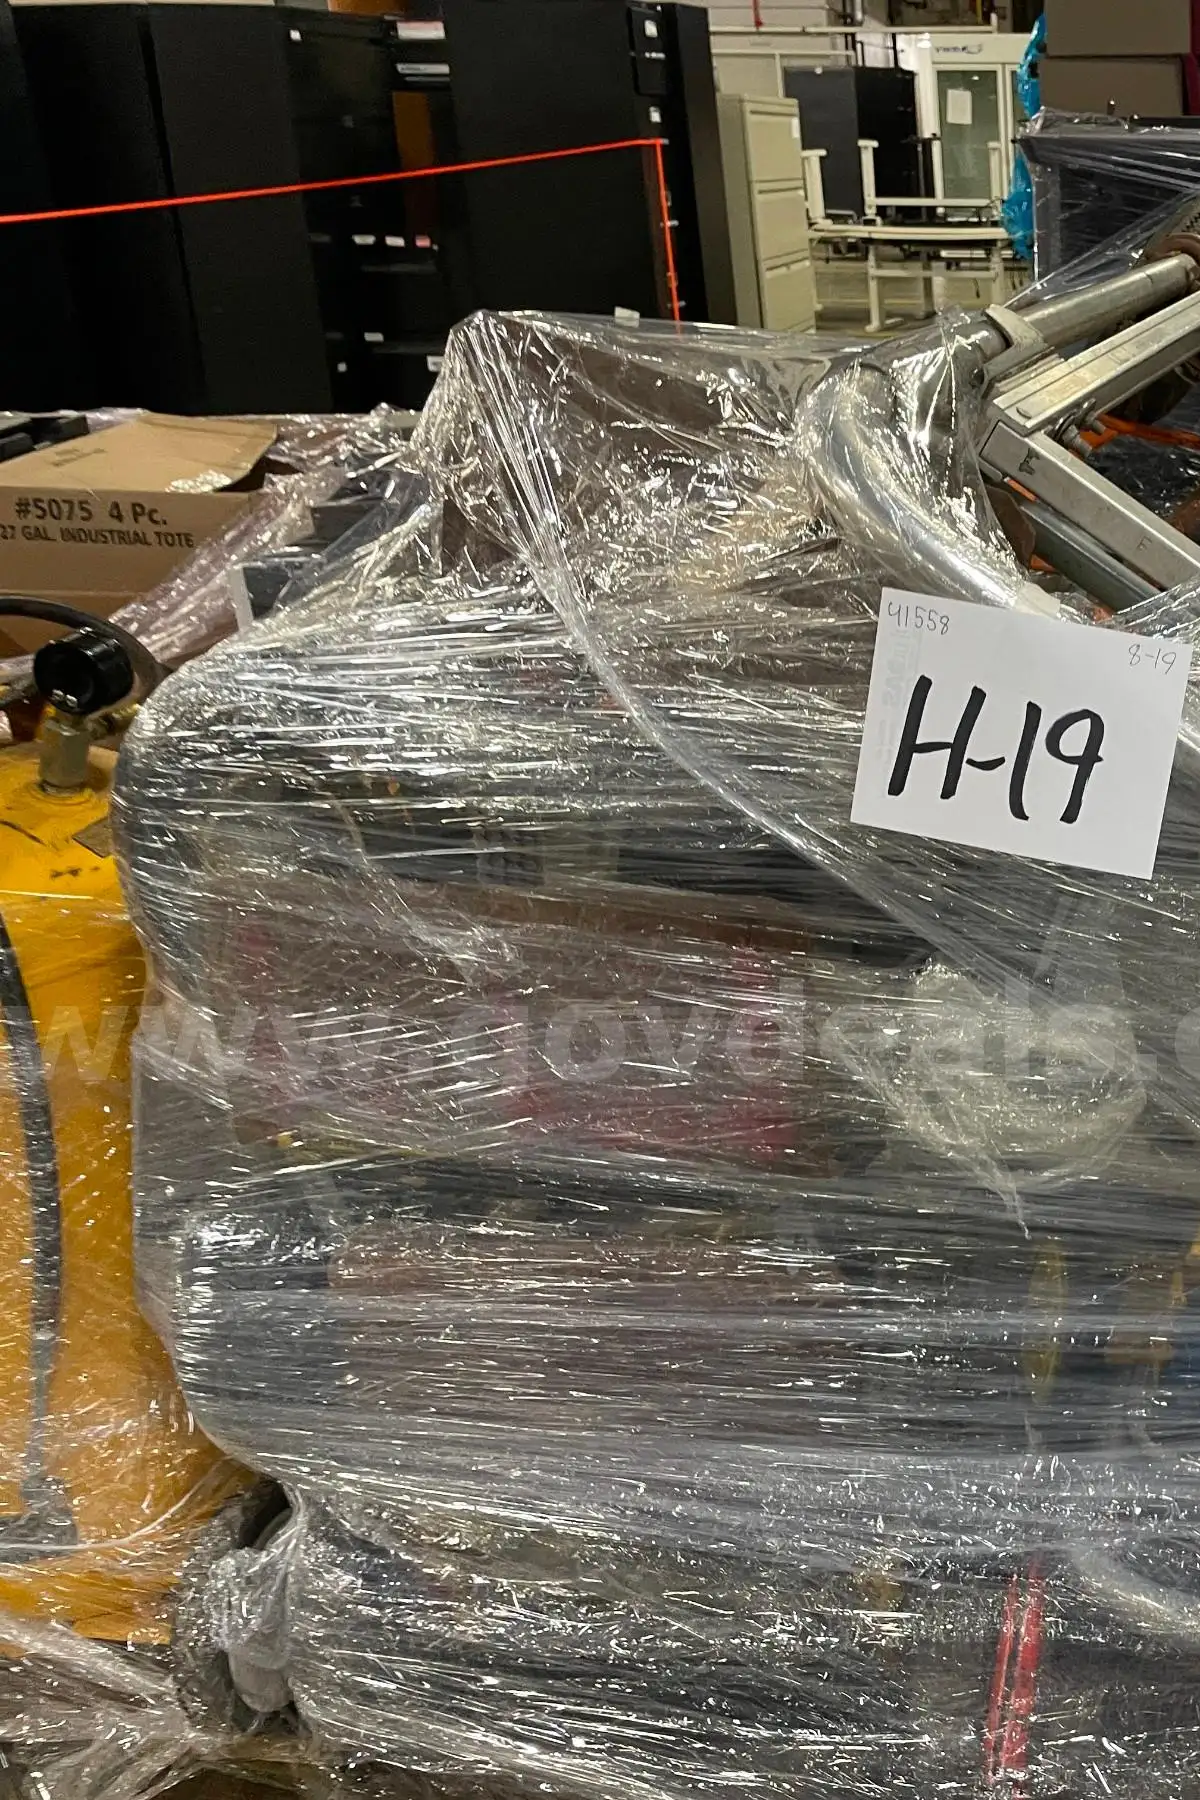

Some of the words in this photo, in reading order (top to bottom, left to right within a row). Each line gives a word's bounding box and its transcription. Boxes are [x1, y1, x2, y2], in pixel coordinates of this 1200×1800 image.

[15, 497, 94, 521] #5075
[108, 501, 124, 523] 4
[131, 502, 168, 525] Pc.
[60, 527, 152, 546] INDUSTRIAL
[153, 532, 194, 548] TOTE
[888, 601, 950, 635] 41558
[1129, 644, 1177, 675] 8-19
[887, 674, 1105, 824] H-19
